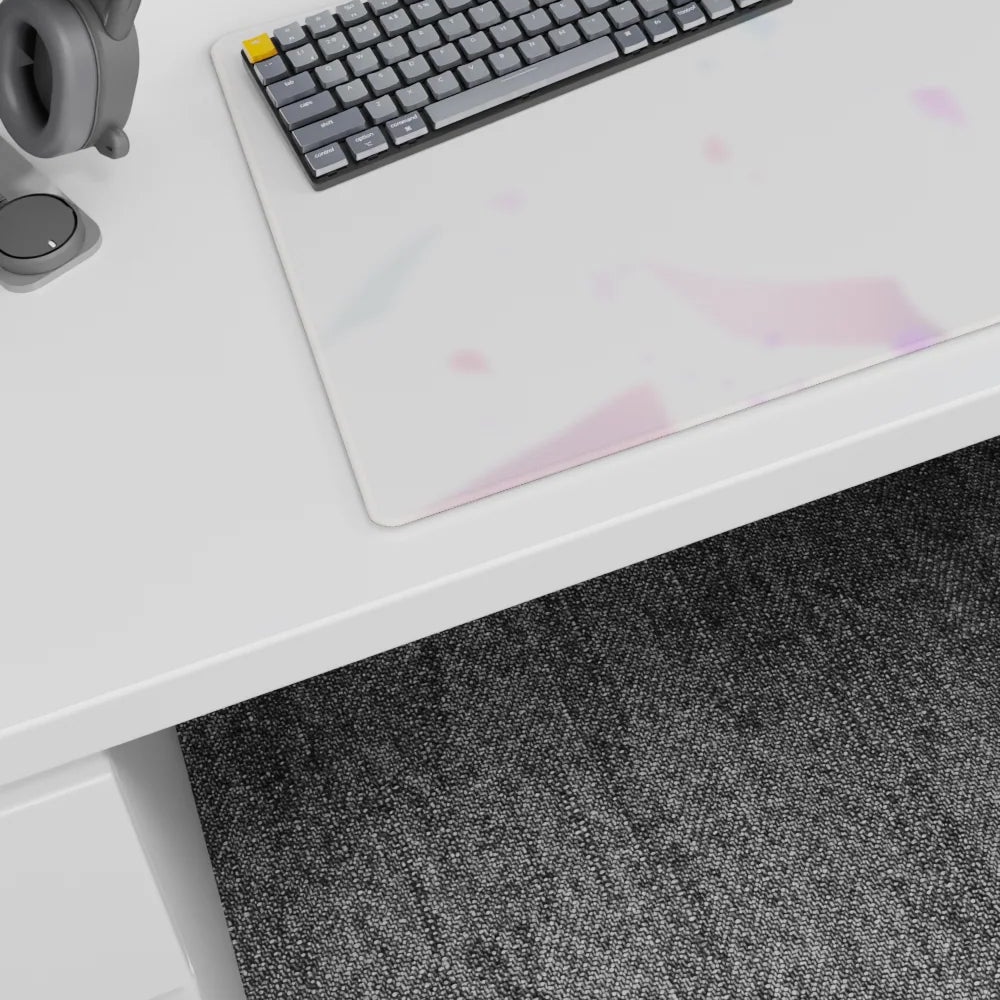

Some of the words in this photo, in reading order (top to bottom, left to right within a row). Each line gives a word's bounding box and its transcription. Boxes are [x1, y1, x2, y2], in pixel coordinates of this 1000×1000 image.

[320, 120, 334, 128] shift
[390, 113, 418, 128] command
[355, 131, 375, 143] option
[314, 146, 335, 159] control
